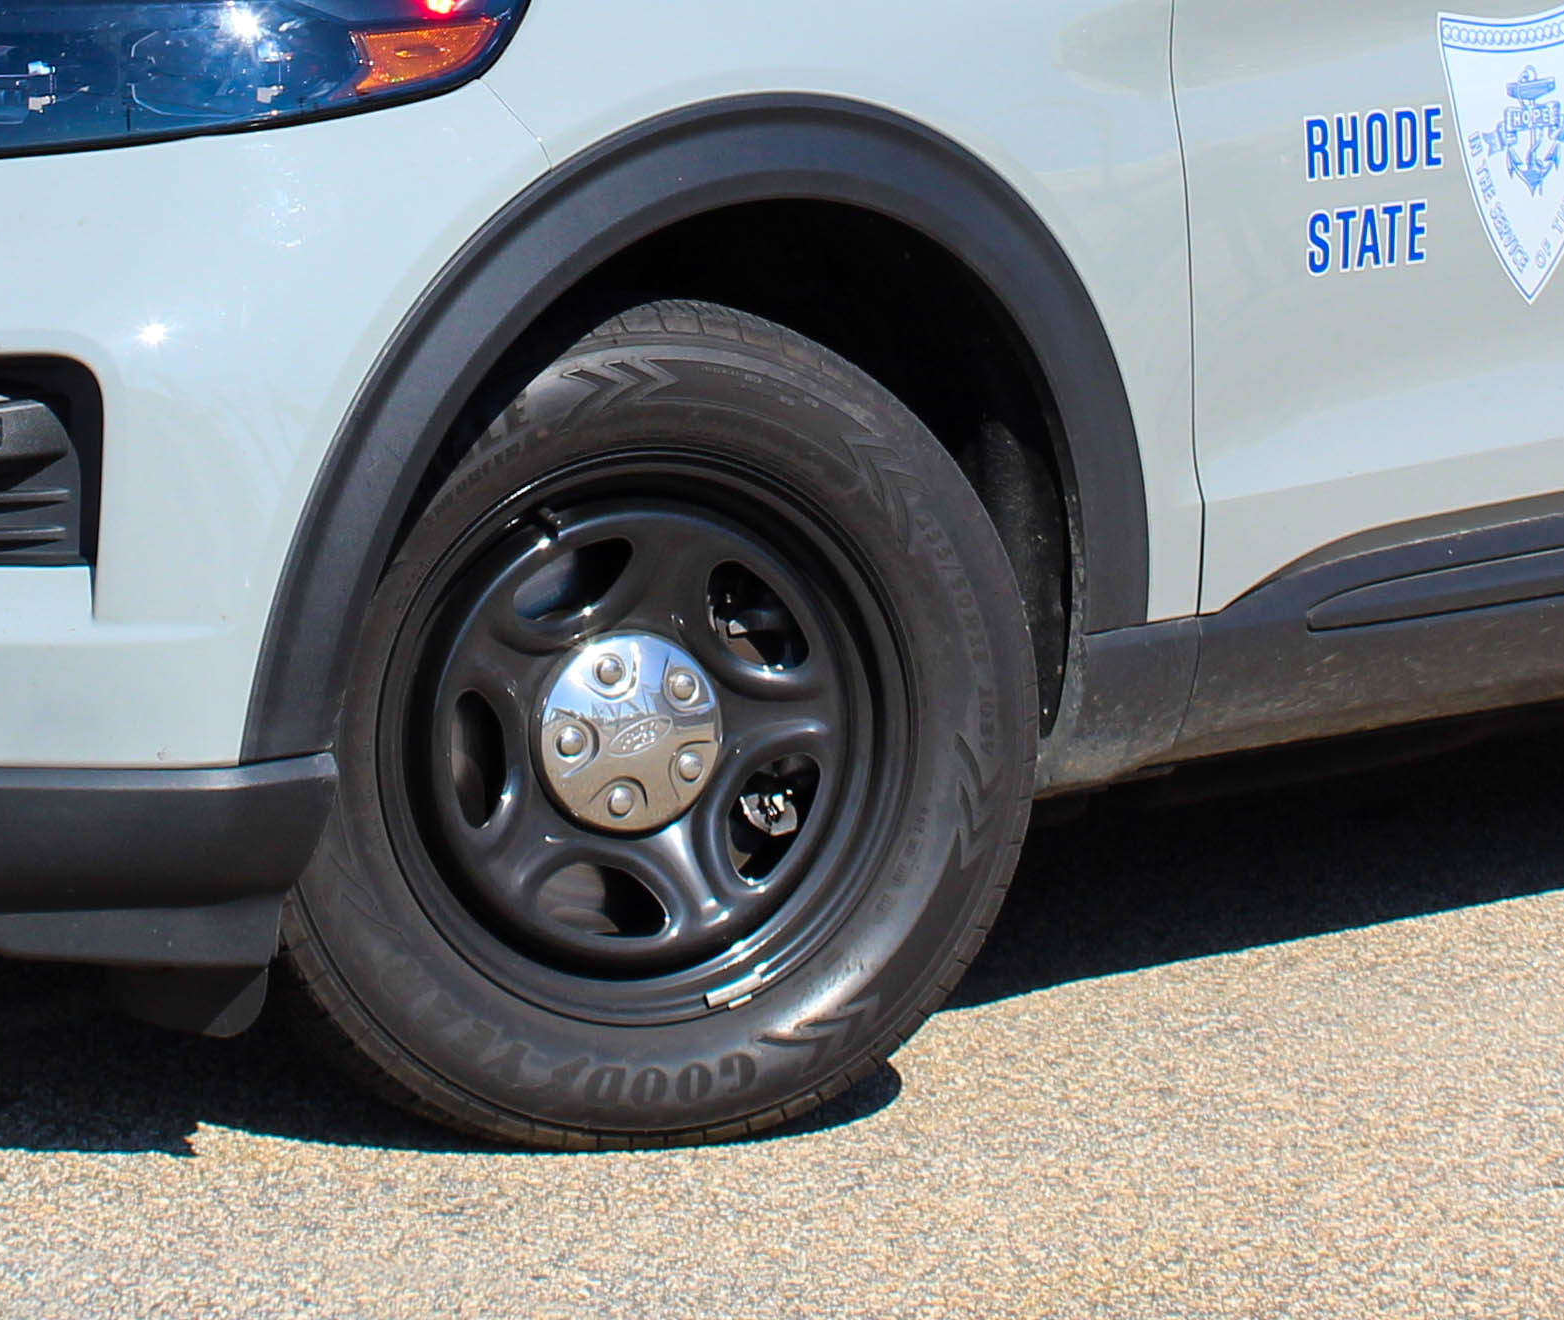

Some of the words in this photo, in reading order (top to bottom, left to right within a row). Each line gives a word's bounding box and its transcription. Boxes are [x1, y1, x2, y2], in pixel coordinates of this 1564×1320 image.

[1304, 104, 1444, 182] RHODE
[1512, 106, 1551, 126] HOPE
[1307, 199, 1428, 276] STATE
